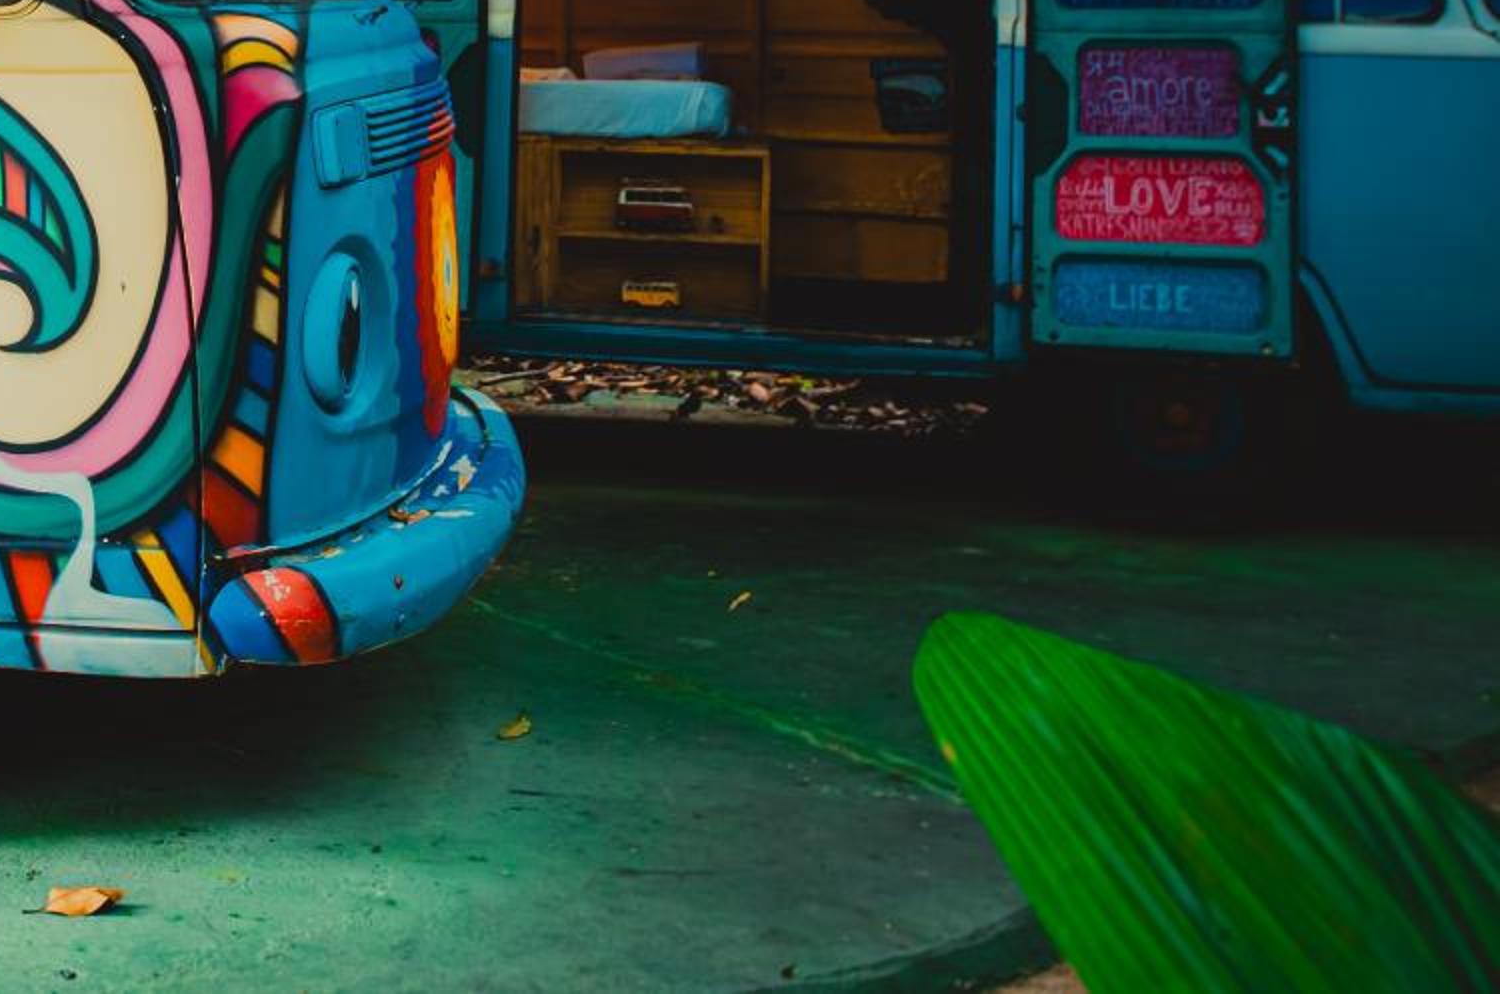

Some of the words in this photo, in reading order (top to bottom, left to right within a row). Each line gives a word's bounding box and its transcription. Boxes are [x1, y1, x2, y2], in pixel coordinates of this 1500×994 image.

[1106, 75, 1212, 107] amore
[1102, 175, 1213, 216] LOVE
[1109, 281, 1192, 312] LIEBE
